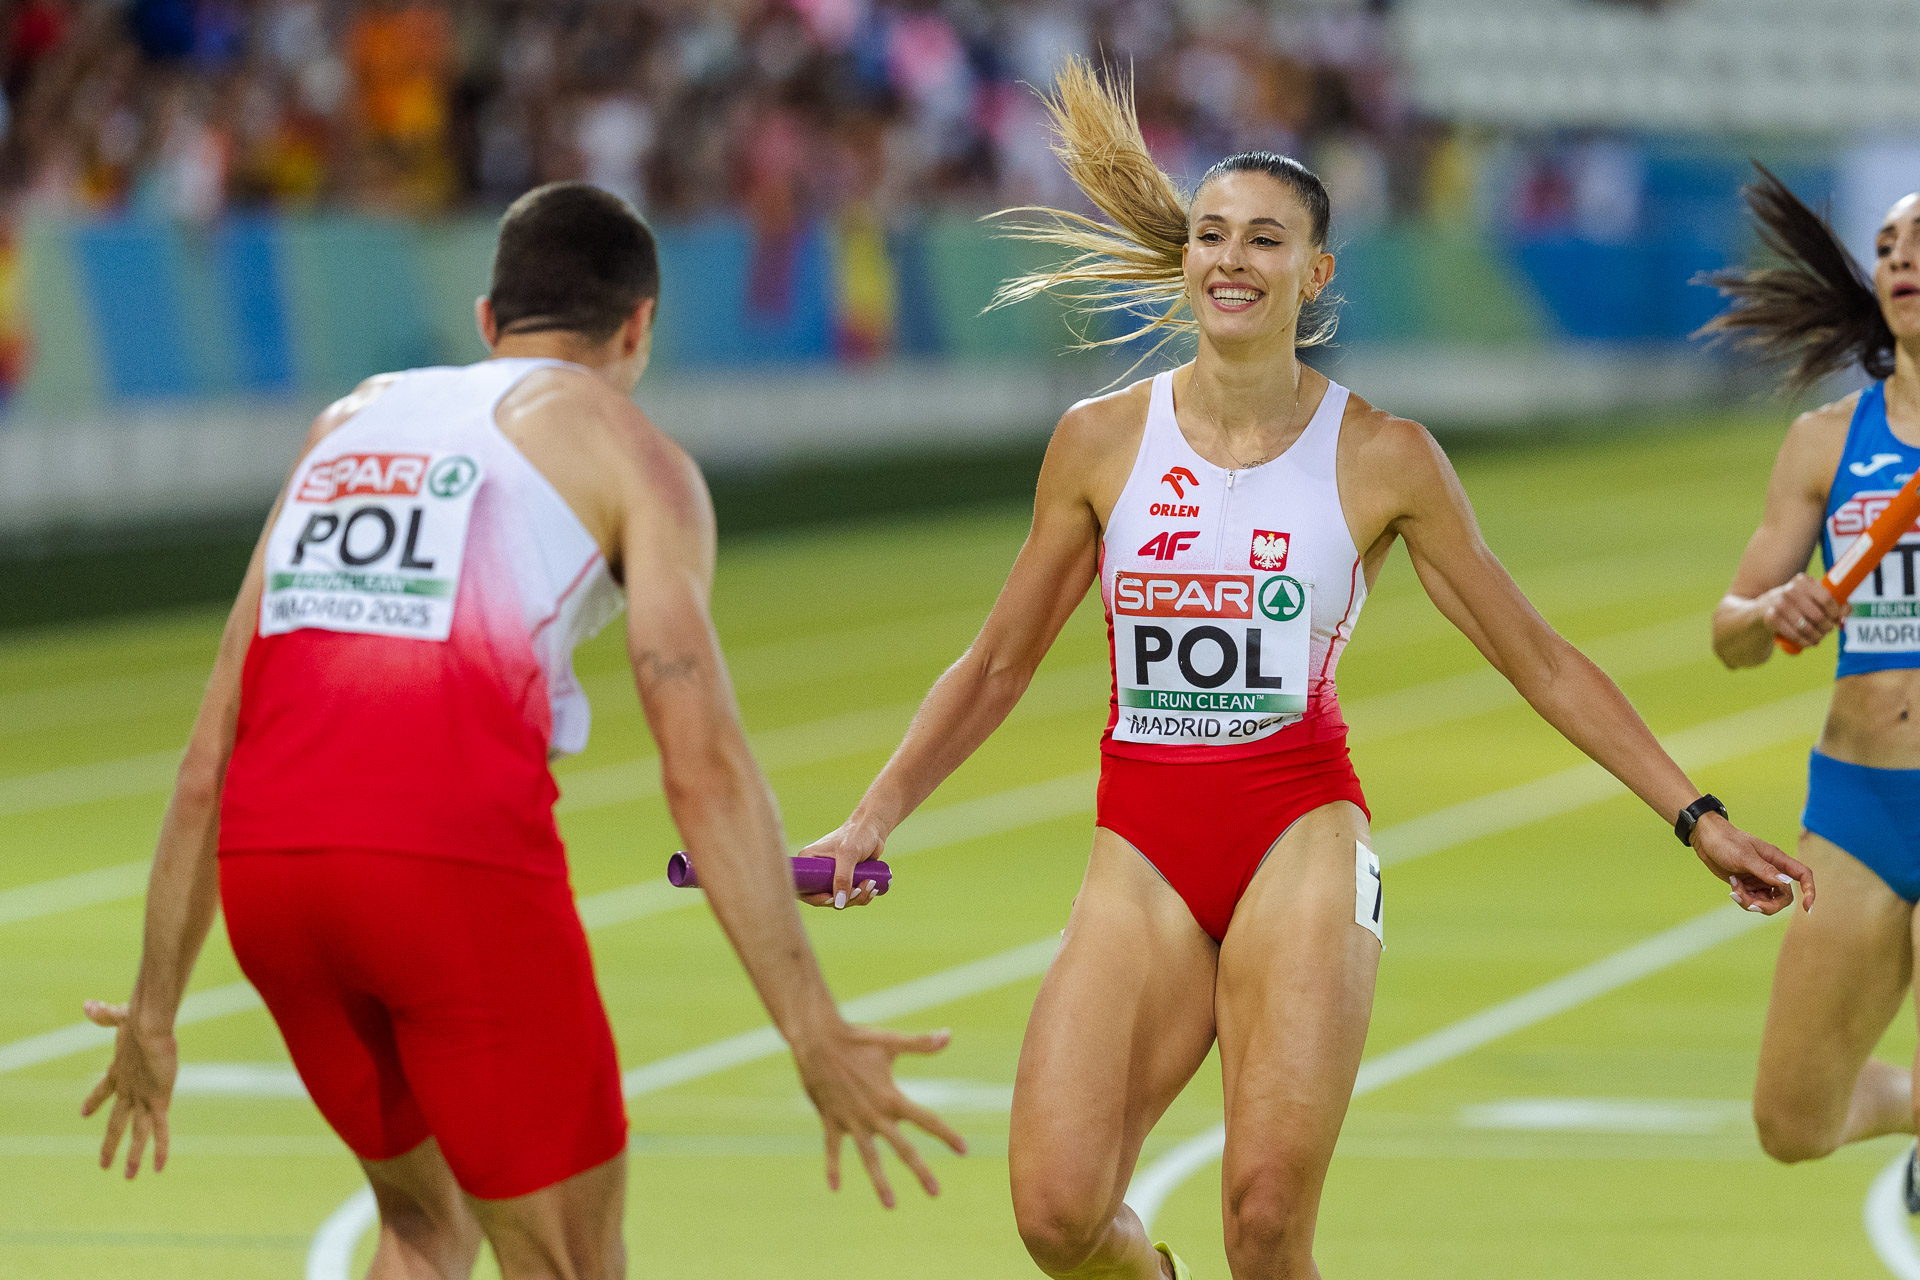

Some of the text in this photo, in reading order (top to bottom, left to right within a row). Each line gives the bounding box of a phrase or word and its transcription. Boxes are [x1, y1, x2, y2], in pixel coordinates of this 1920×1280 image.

[300, 457, 424, 499] SPAR
[1150, 503, 1200, 518] ORLEN
[1835, 499, 1920, 531] SP
[291, 507, 434, 570] POL
[1138, 531, 1200, 560] 4F
[1118, 578, 1249, 613] SPAR
[1858, 624, 1920, 643] MADR
[1134, 625, 1282, 689] POL
[1150, 692, 1154, 707] I
[1158, 692, 1192, 708] RUN
[1130, 715, 1221, 737] MADRID
